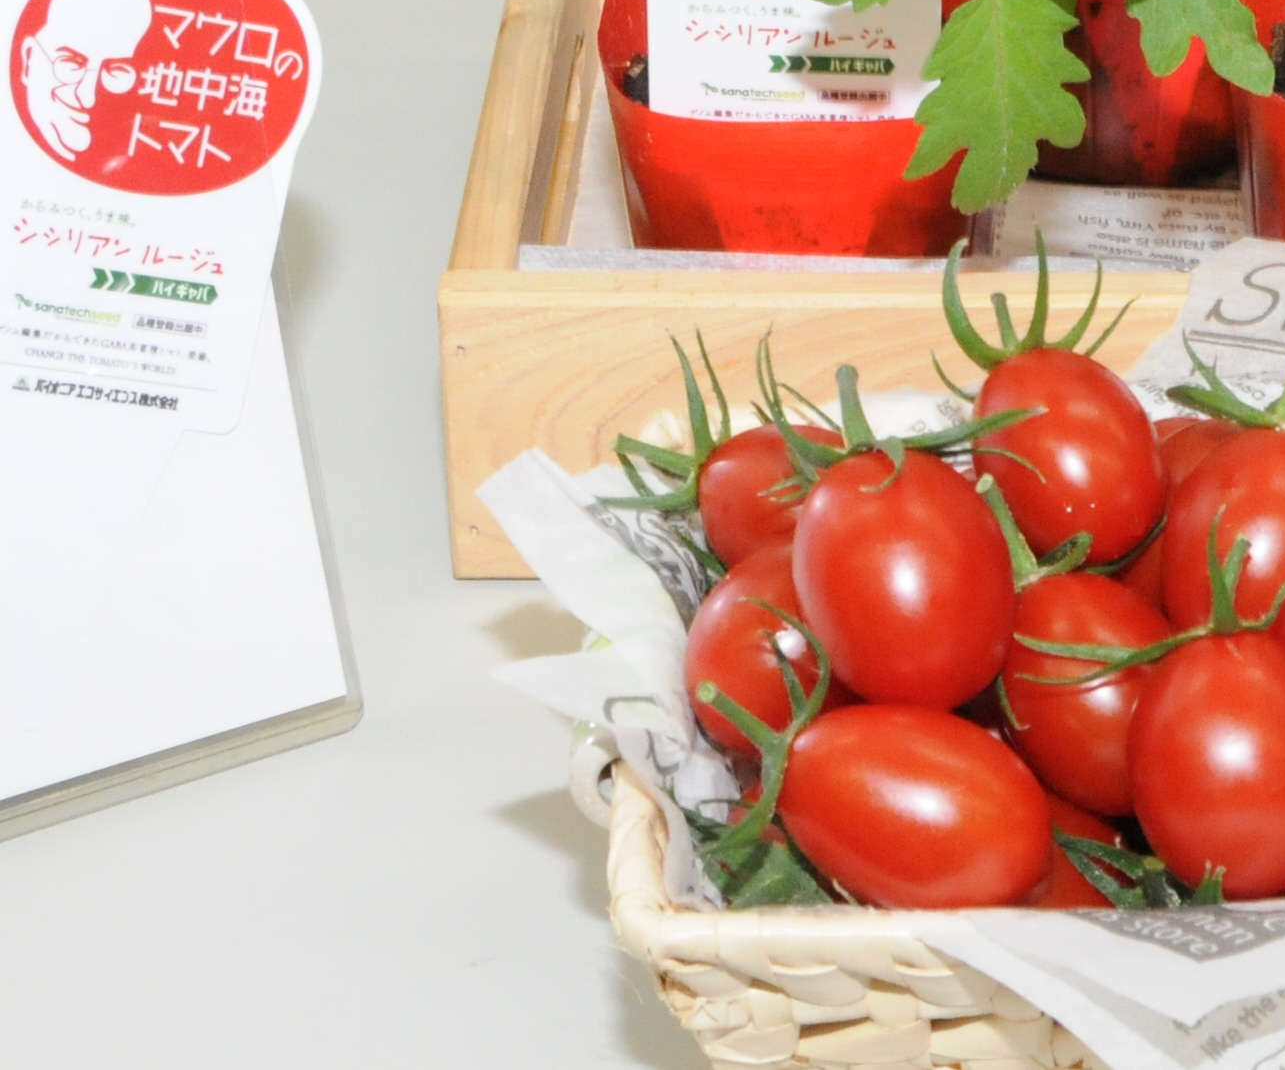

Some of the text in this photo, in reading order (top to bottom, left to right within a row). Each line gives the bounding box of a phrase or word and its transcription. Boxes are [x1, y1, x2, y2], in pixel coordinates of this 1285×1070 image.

[153, 4, 304, 81] マウロの
[684, 19, 897, 49] シシリアン ルージュ
[829, 57, 888, 74] ハイギャバ
[137, 61, 269, 121] 地中海
[720, 86, 806, 100] sanatechseed
[127, 113, 232, 169] トマト
[13, 217, 225, 275] シシリアン ルージュ
[151, 278, 212, 303] ハイギャバ
